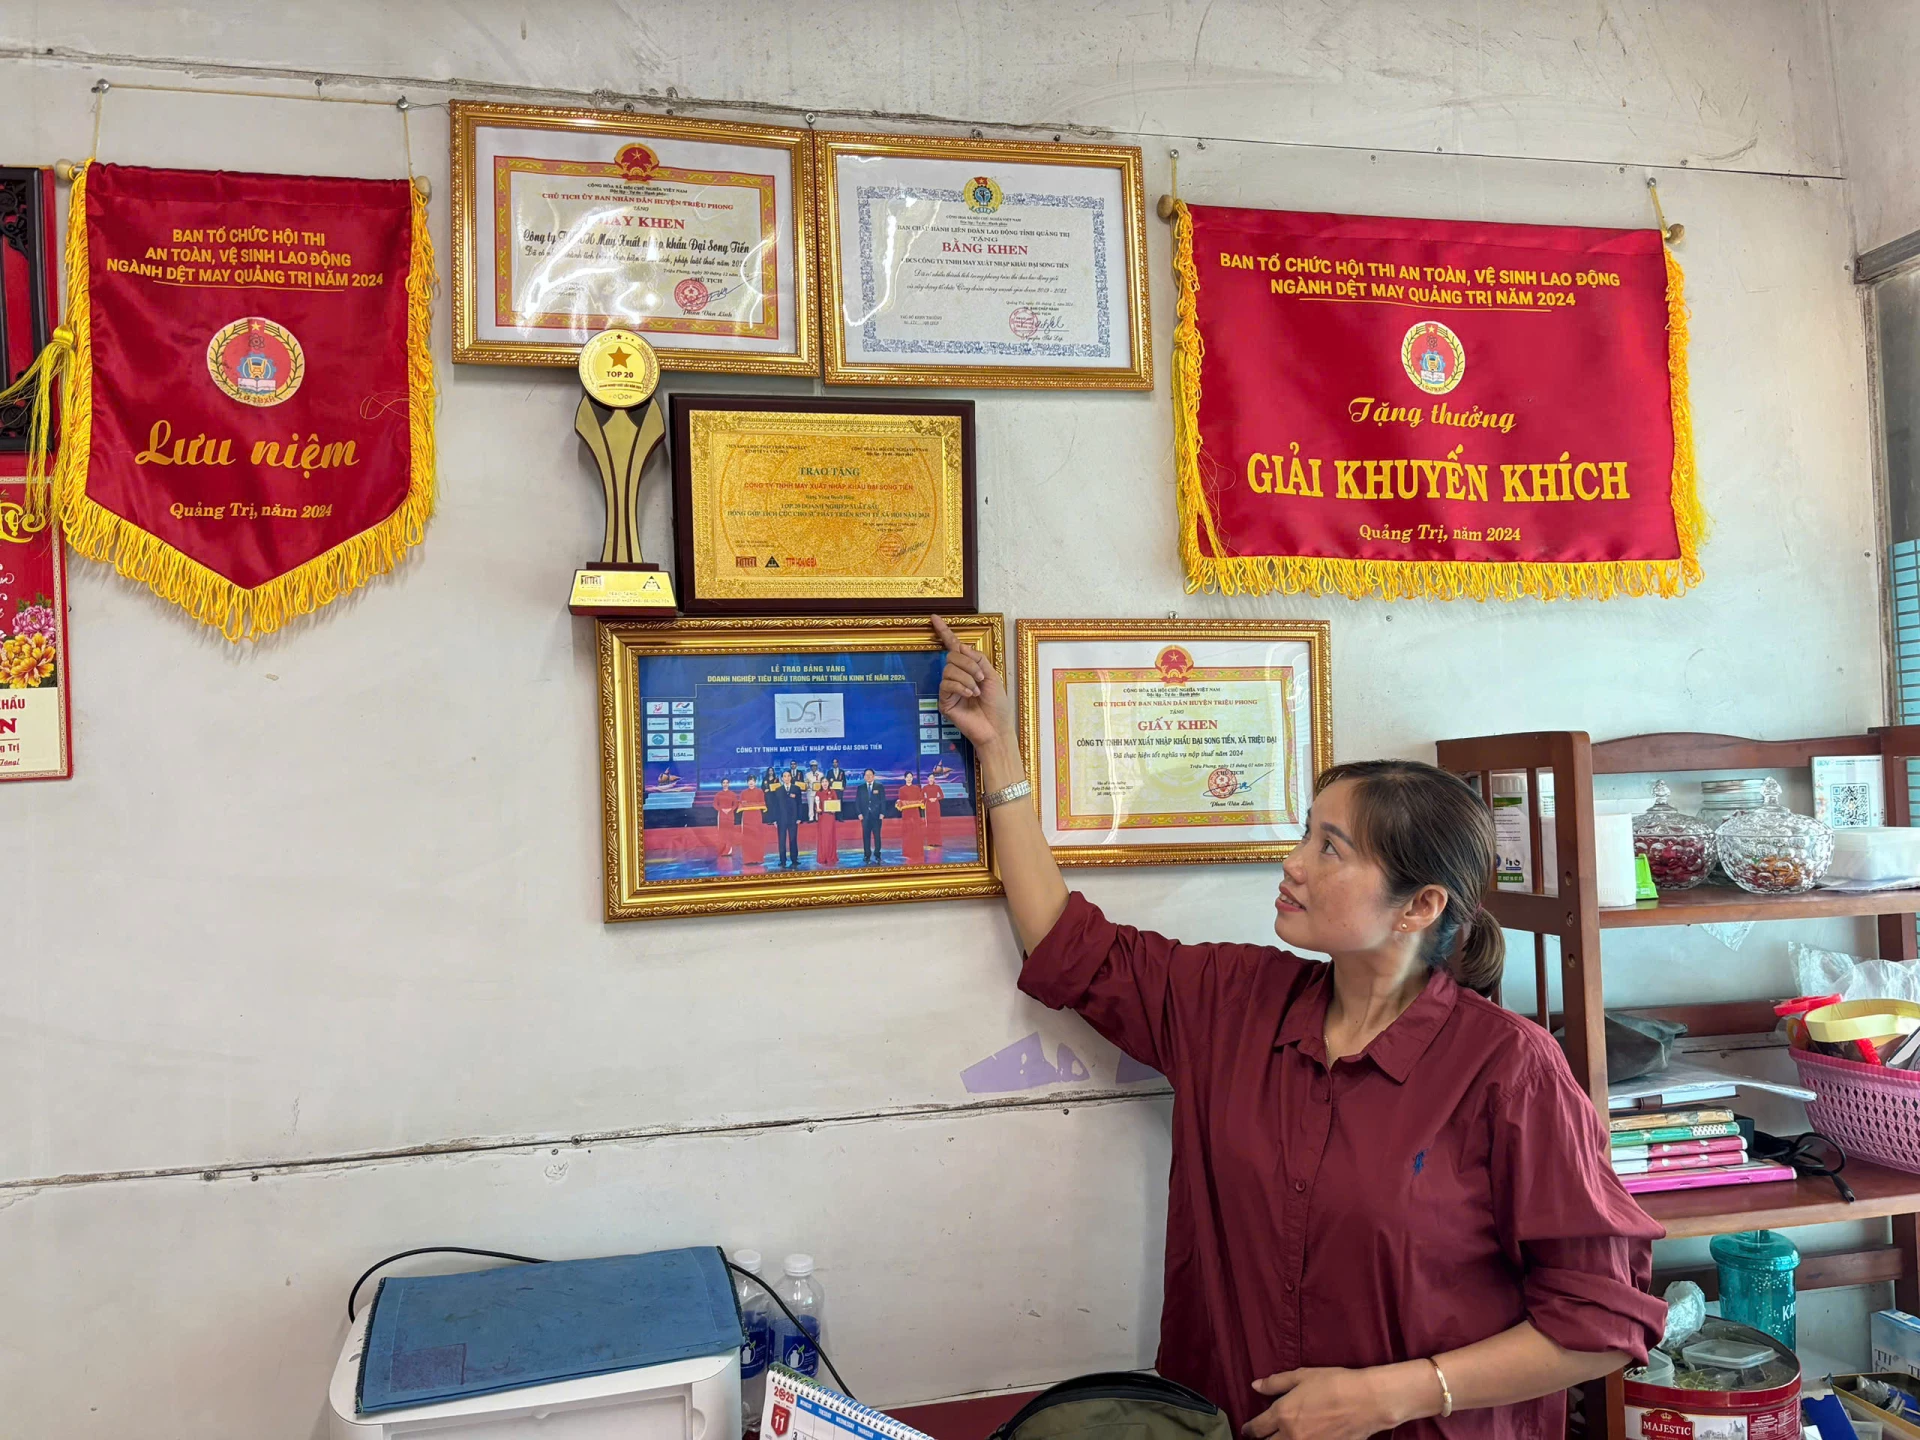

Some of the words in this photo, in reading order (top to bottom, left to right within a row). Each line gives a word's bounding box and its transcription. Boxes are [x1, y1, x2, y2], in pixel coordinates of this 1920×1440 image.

[638, 218, 685, 230] KHEN
[173, 229, 203, 243] BAN
[206, 226, 226, 243] TỔ
[229, 225, 268, 243] CHỨC
[272, 228, 297, 246] HỘI
[301, 232, 325, 246] THI
[942, 238, 982, 254] BẰNG
[987, 244, 1028, 255] KHEN
[145, 247, 167, 261] AN
[171, 246, 215, 265] TOÀN,
[219, 247, 238, 265] VỆ
[241, 249, 274, 263] SINH
[278, 250, 307, 265] LAO
[309, 251, 351, 269] ĐỘNG
[106, 258, 162, 278] NGÀNH
[166, 265, 195, 283] DỆT
[198, 269, 231, 282] MAY
[234, 265, 285, 284] QUẢNG
[288, 271, 312, 288] TRỊ
[315, 269, 348, 287] NĂM
[351, 272, 383, 287] 2024
[1220, 253, 1254, 270] BAN
[1257, 253, 1280, 272] TỔ
[1285, 256, 1332, 274] CHỨC
[1335, 259, 1364, 279] HỘI
[1367, 262, 1395, 278] THI
[1399, 265, 1420, 281] AN
[1423, 265, 1470, 287] TOÀN,
[1474, 266, 1496, 286] VỆ
[1499, 269, 1536, 285] SINH
[1541, 272, 1572, 286] LAO
[1575, 269, 1620, 288] ĐỘNG
[1270, 276, 1332, 295] NGÀNH
[1336, 279, 1367, 299] DỆT
[1371, 283, 1405, 299] MAY
[1408, 284, 1462, 304] QUẢNG
[1465, 291, 1492, 307] TRỊ
[1496, 287, 1533, 305] NĂM
[1536, 292, 1576, 306] 2024
[1348, 397, 1424, 428] Tặng
[1430, 402, 1516, 433] thưởng
[134, 420, 236, 465] Lưu
[250, 433, 360, 479] niệm
[800, 467, 828, 476] TRAO
[831, 467, 861, 478] TẶNG
[1247, 441, 1324, 498] GIẢI
[1334, 443, 1489, 502] KHUYẾN
[1500, 450, 1631, 502] KHÍCH
[170, 502, 225, 519] Quảng
[230, 502, 258, 520] Trị,
[261, 503, 297, 518] năm
[300, 504, 332, 518] 2024
[1359, 524, 1413, 543] Quảng
[1417, 524, 1448, 543] Trị,
[1452, 526, 1482, 541] năm
[1486, 527, 1521, 541] 2024
[0, 694, 25, 710] HẨU
[1110, 700, 1126, 708] TỊCH
[1127, 699, 1138, 707] ỦY
[1189, 699, 1213, 707] HUYỆN
[1137, 716, 1174, 731] GIẤY
[1177, 720, 1218, 730] KHEN
[1076, 738, 1095, 747] CÔNG
[1095, 739, 1104, 747] TY
[1123, 739, 1137, 747] MAY
[1137, 736, 1154, 747] XUẤT
[1154, 738, 1173, 747] NHẬP
[1173, 735, 1191, 745] KHẨU
[1192, 738, 1203, 746] ĐẠI
[1222, 734, 1237, 745] TIẾN,
[1237, 736, 1247, 744] XÃ
[1248, 736, 1266, 744] TRIỆU
[1266, 736, 1277, 744] ĐẠI
[774, 1414, 785, 1431] 11
[1643, 1420, 1691, 1436] MAJESTIC
